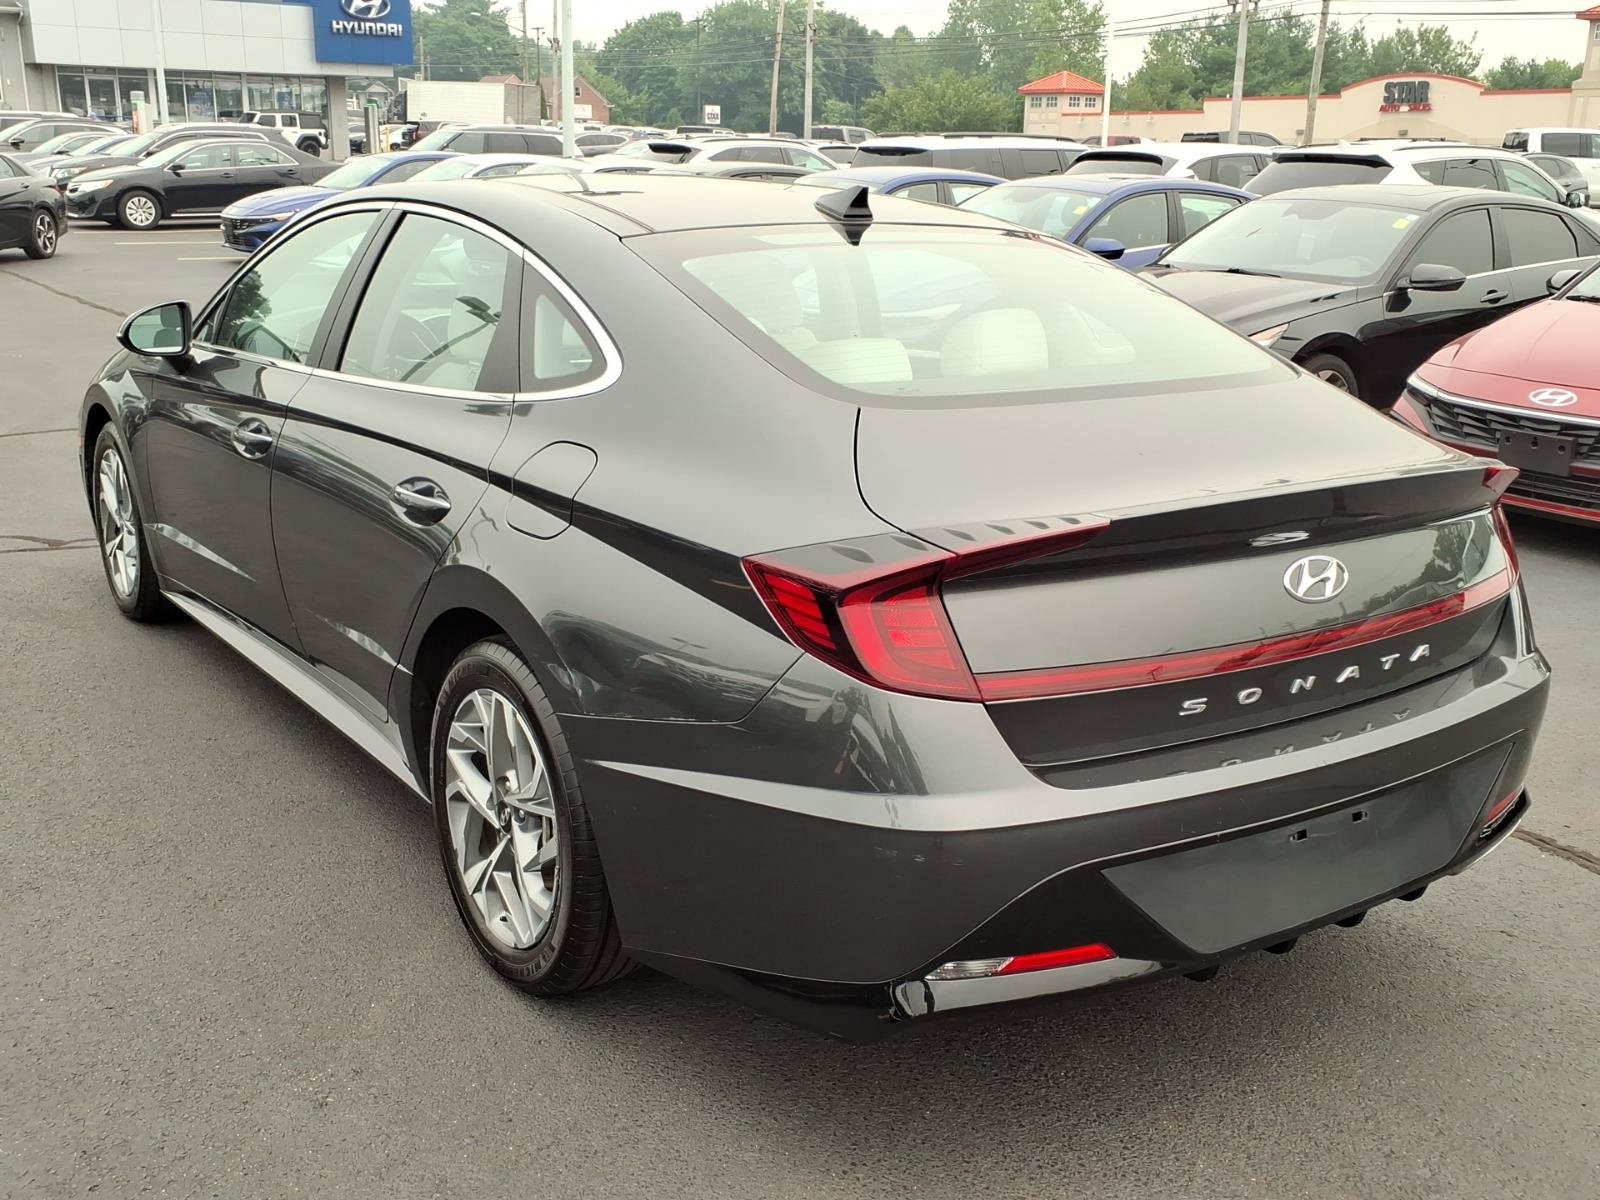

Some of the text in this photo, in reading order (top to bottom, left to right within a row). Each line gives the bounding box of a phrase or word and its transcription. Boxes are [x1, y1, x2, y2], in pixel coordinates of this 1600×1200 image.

[332, 19, 404, 37] HYUNDAI
[1383, 80, 1430, 104] STAR
[1379, 103, 1432, 113] AUTO SALES
[1178, 643, 1431, 717] SONATA
